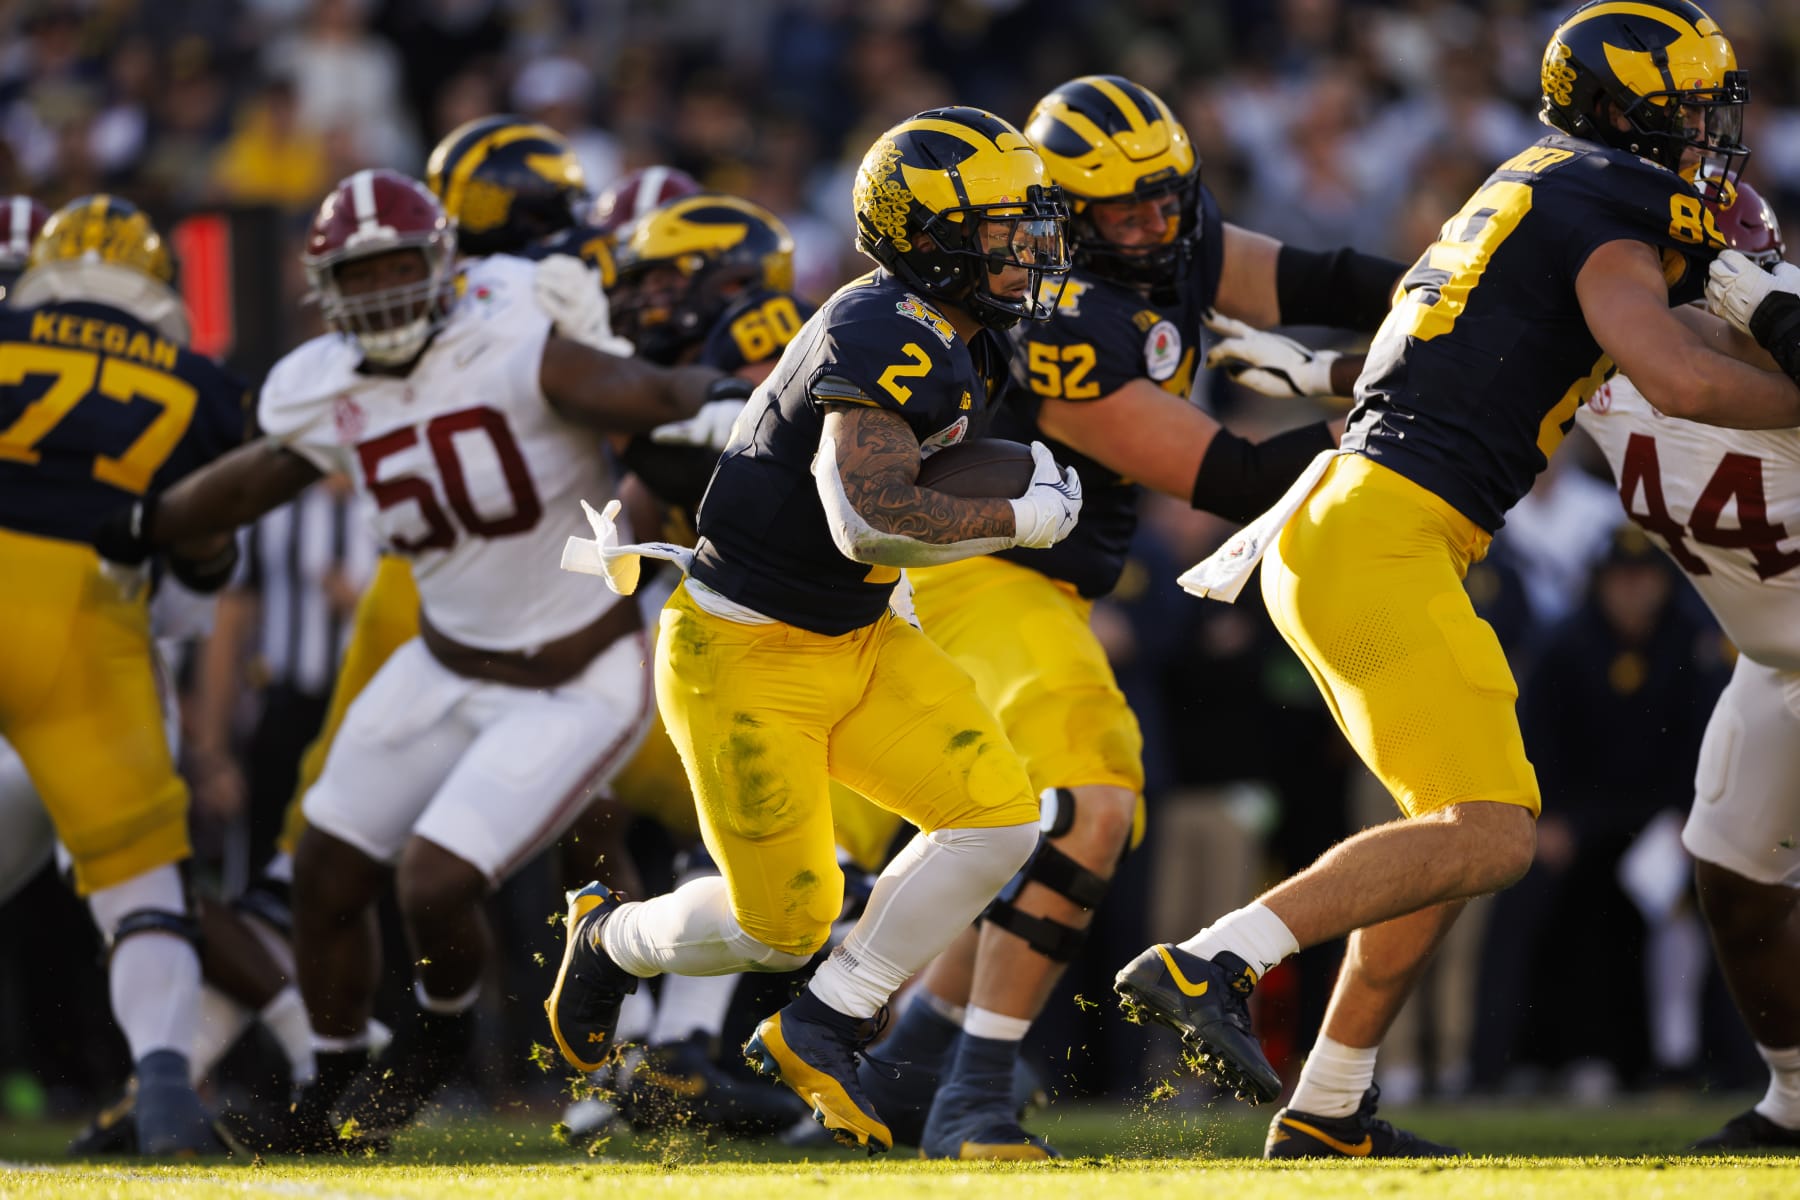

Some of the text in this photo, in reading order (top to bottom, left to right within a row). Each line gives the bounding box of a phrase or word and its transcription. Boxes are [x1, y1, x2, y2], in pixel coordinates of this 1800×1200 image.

[31, 310, 178, 371] KEEGAN
[729, 297, 803, 361] 60
[876, 342, 933, 406] 2
[1030, 340, 1100, 400] 52
[0, 341, 198, 496] 77
[357, 404, 543, 554] 50
[1619, 431, 1800, 584] 44
[587, 1031, 606, 1043] M
